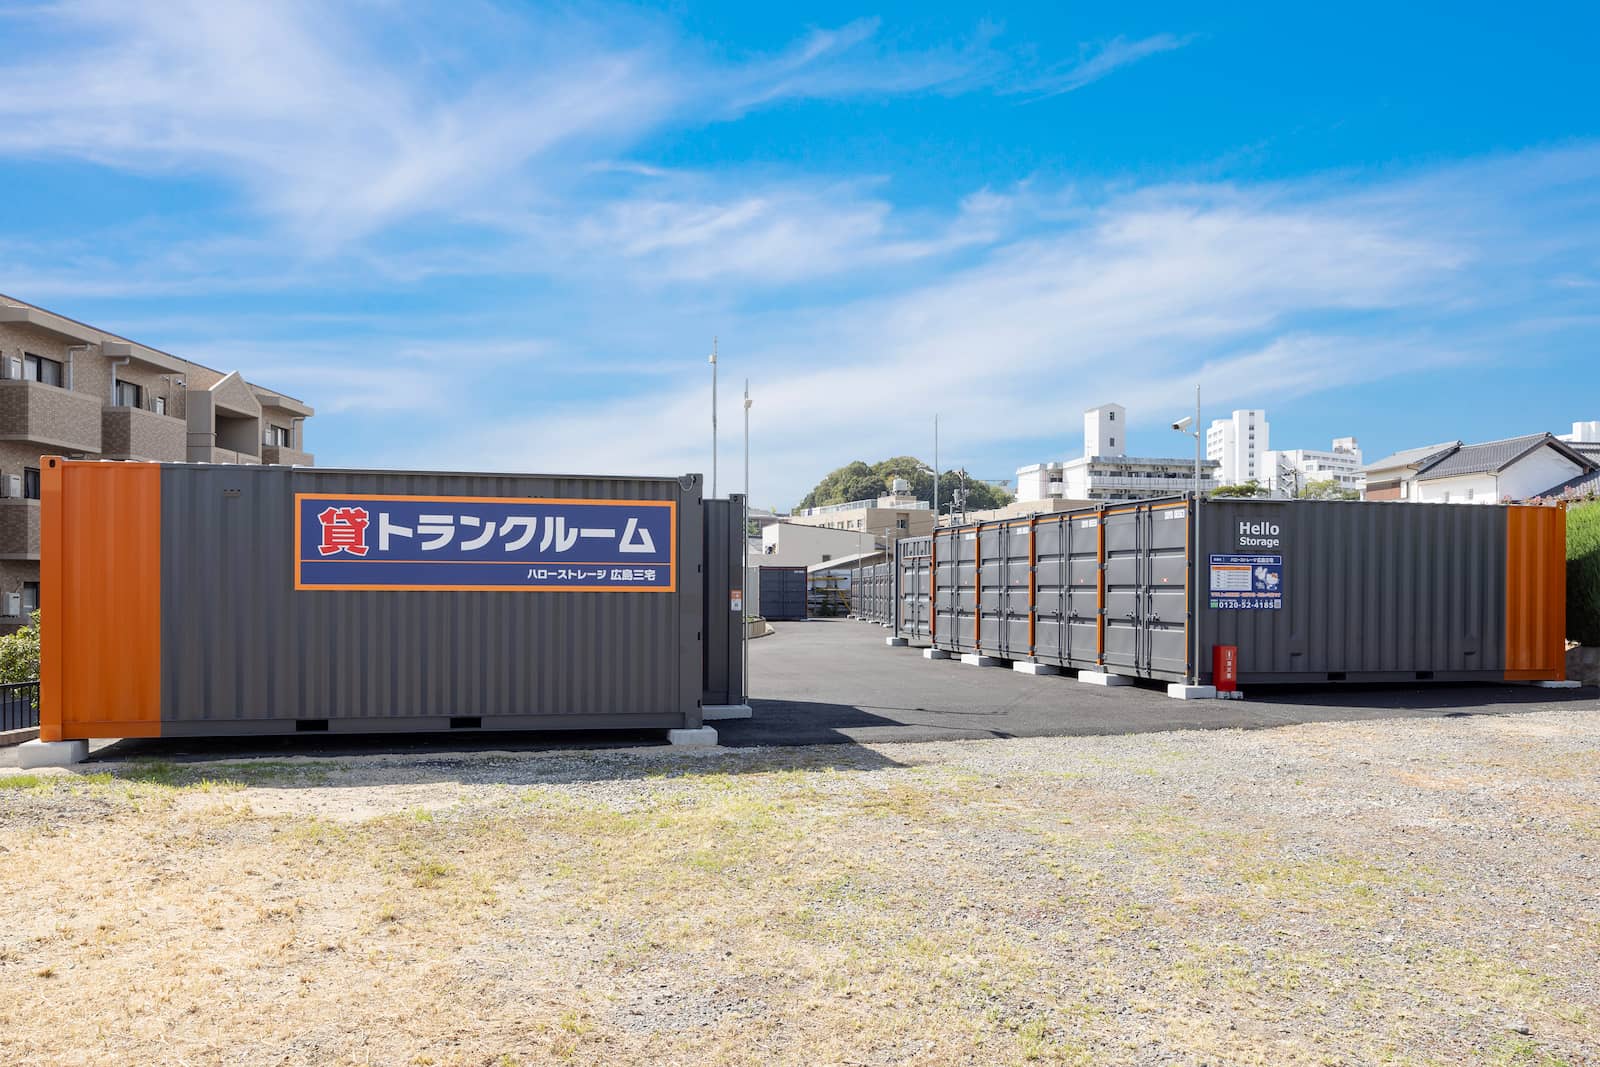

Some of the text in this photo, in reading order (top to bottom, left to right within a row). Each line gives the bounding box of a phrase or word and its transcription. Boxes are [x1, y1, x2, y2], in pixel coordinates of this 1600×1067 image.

[317, 507, 656, 557] 貸トランクルーム
[1239, 521, 1280, 536] Hello
[1239, 536, 1280, 548] Storage
[527, 568, 656, 581] ハローストレージ 広島三宅
